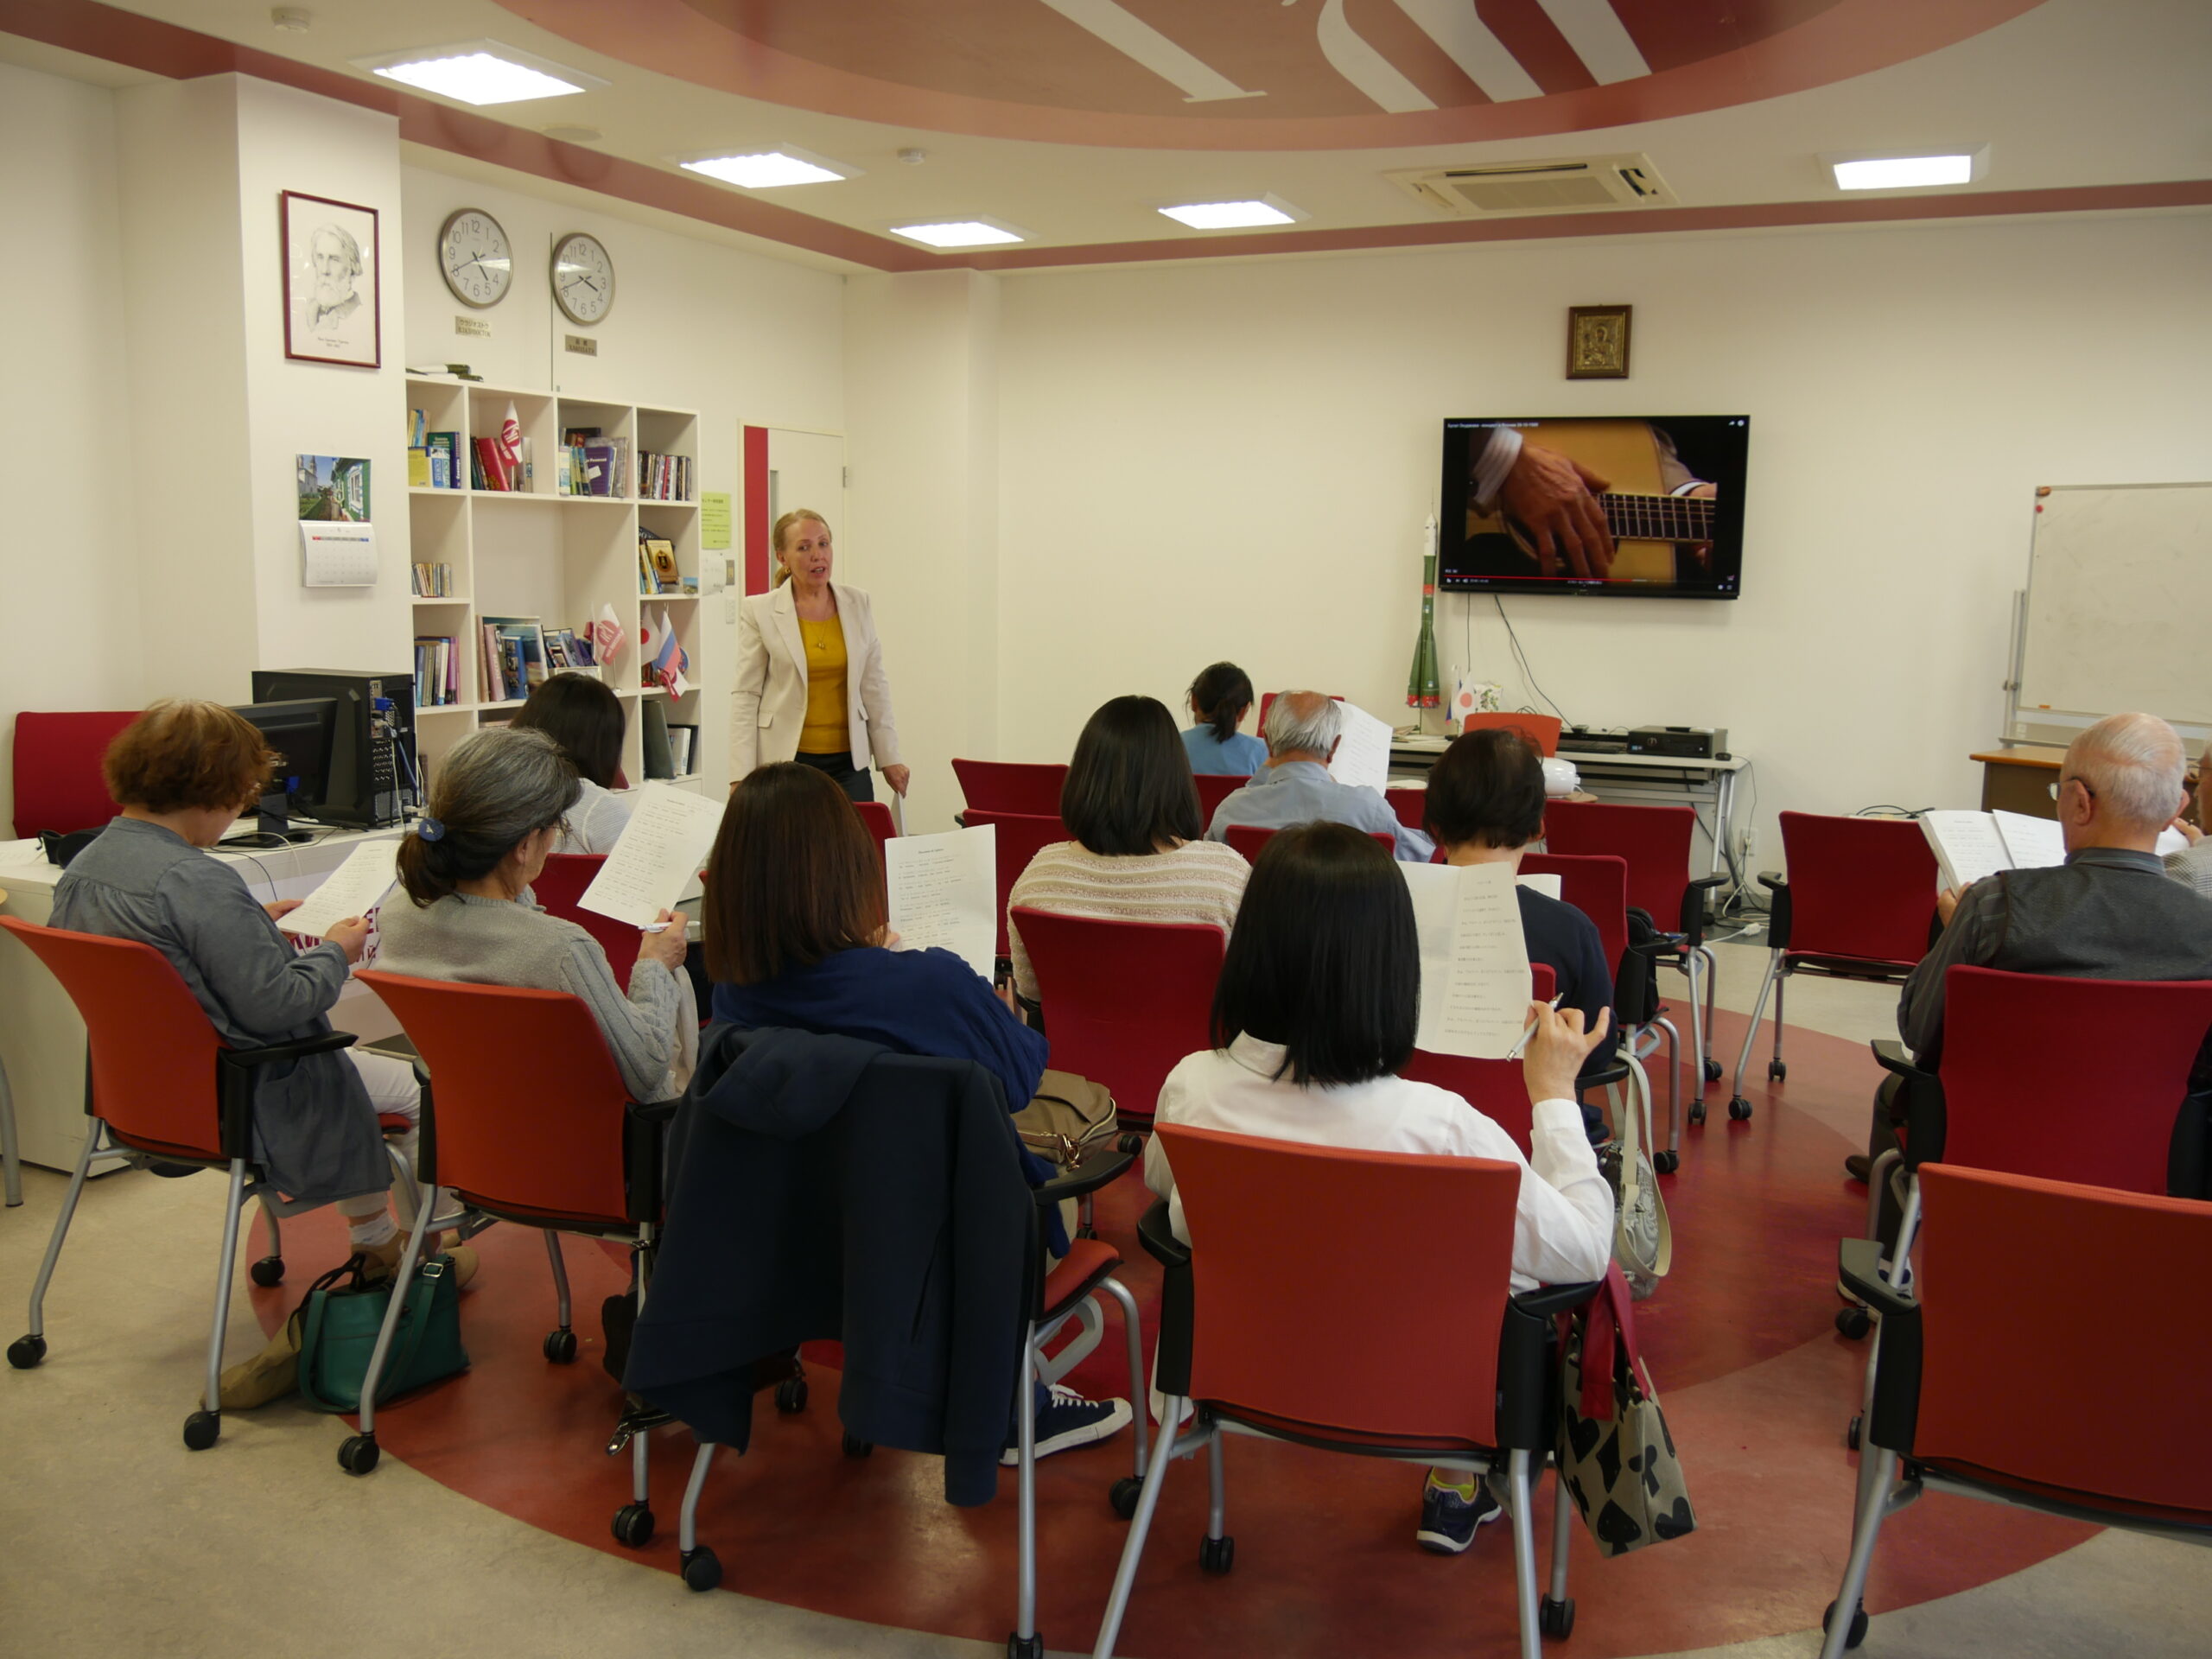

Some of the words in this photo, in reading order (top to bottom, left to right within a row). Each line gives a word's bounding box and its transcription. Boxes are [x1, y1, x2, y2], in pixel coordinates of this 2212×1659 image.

[461, 221, 469, 235] 11
[471, 219, 480, 233] 12
[452, 230, 461, 244] 10
[448, 246, 456, 259] 9
[493, 239, 499, 253] 2
[578, 242, 587, 256] 12
[596, 261, 603, 273] 2
[463, 277, 469, 290] 7
[493, 273, 499, 286] 4
[601, 277, 607, 290] 3
[473, 283, 480, 296] 6
[485, 283, 492, 296] 5
[572, 297, 577, 310] 7
[597, 292, 603, 304] 4
[581, 302, 587, 315] 6
[590, 301, 596, 313] 5
